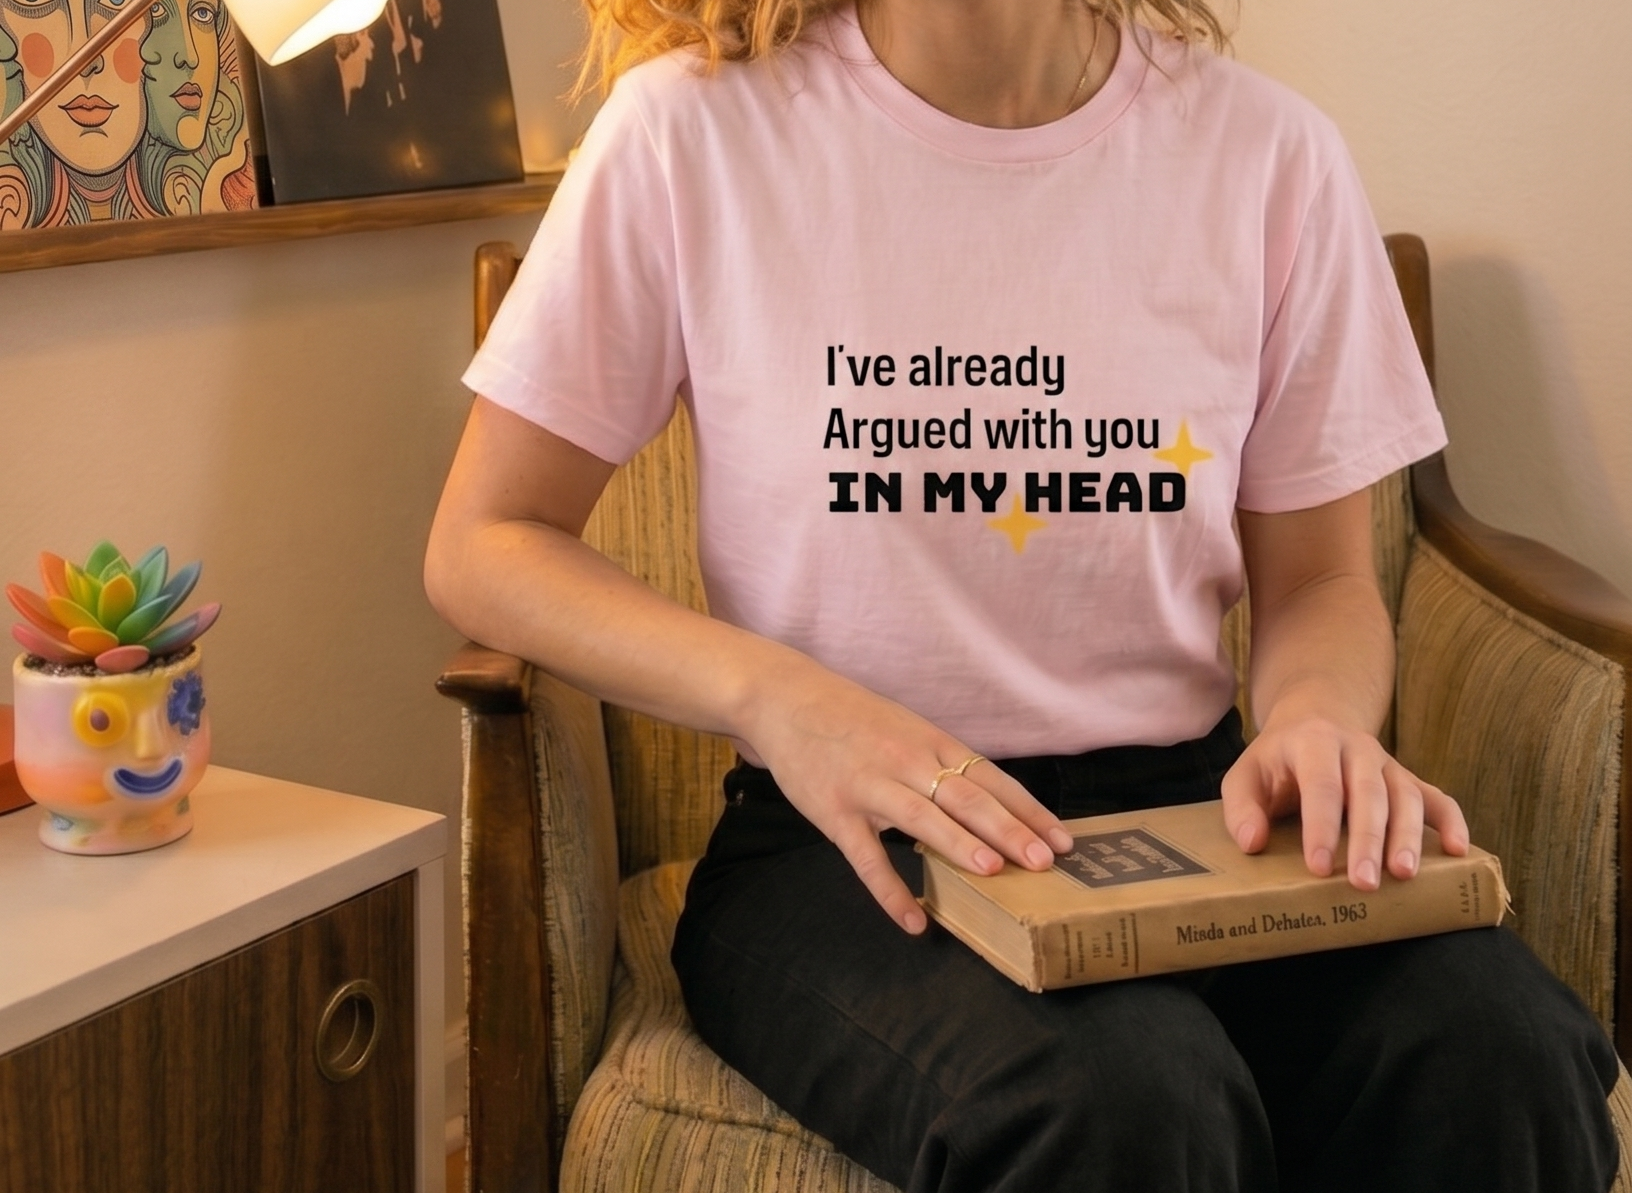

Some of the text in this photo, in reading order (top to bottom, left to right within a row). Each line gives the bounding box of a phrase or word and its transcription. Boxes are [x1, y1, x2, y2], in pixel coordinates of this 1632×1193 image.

[826, 344, 1066, 396] I've already
[823, 407, 1160, 458] Argued with you
[828, 471, 1187, 513] IN MY HEAD
[1229, 916, 1258, 938] and
[1331, 902, 1368, 924] 1963
